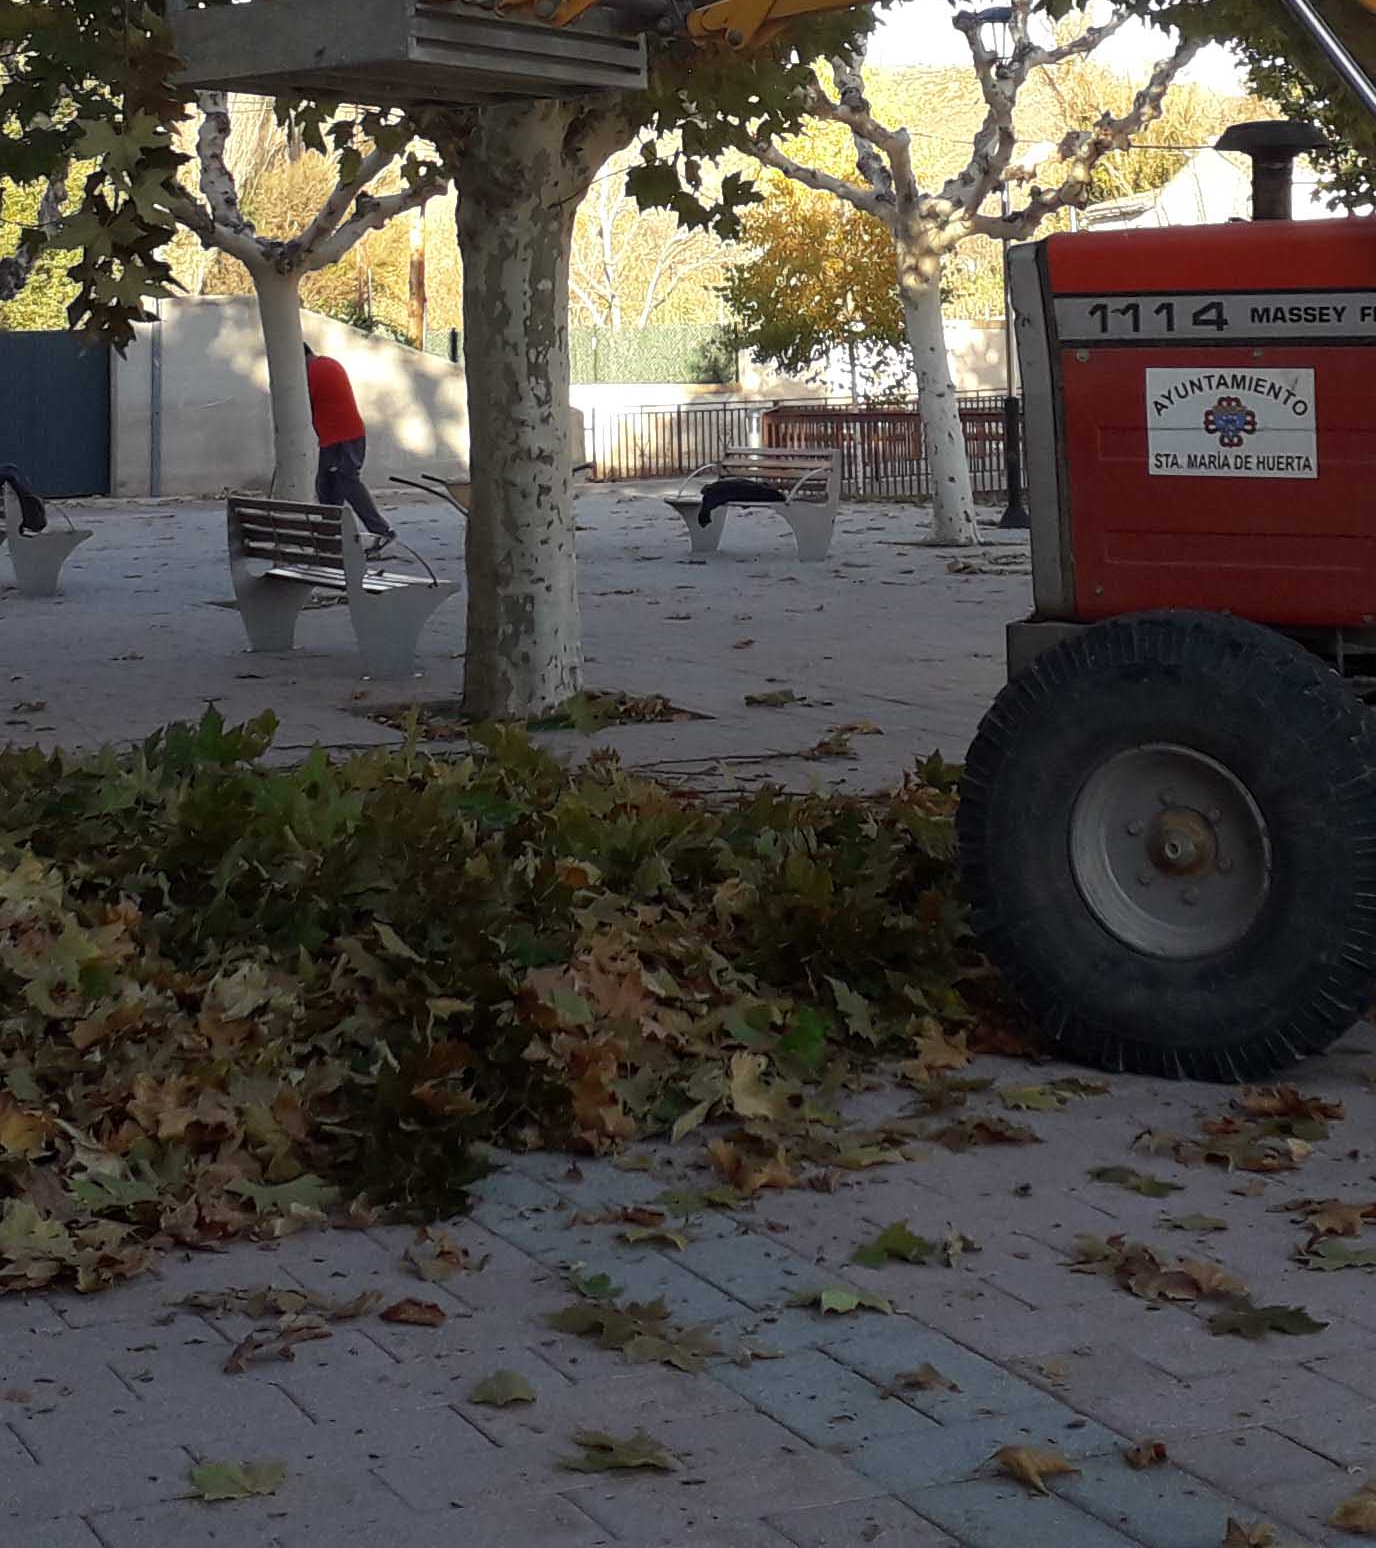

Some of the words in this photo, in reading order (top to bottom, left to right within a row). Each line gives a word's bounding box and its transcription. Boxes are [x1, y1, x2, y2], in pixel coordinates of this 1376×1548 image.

[1088, 301, 1228, 333] 1114
[1250, 305, 1346, 324] MASSEY
[1153, 374, 1308, 417] AYUNTAMIENTO
[1154, 453, 1183, 469] STA.
[1187, 451, 1229, 470] MARÍA
[1234, 455, 1252, 470] DE
[1256, 455, 1313, 471] HUERTA
